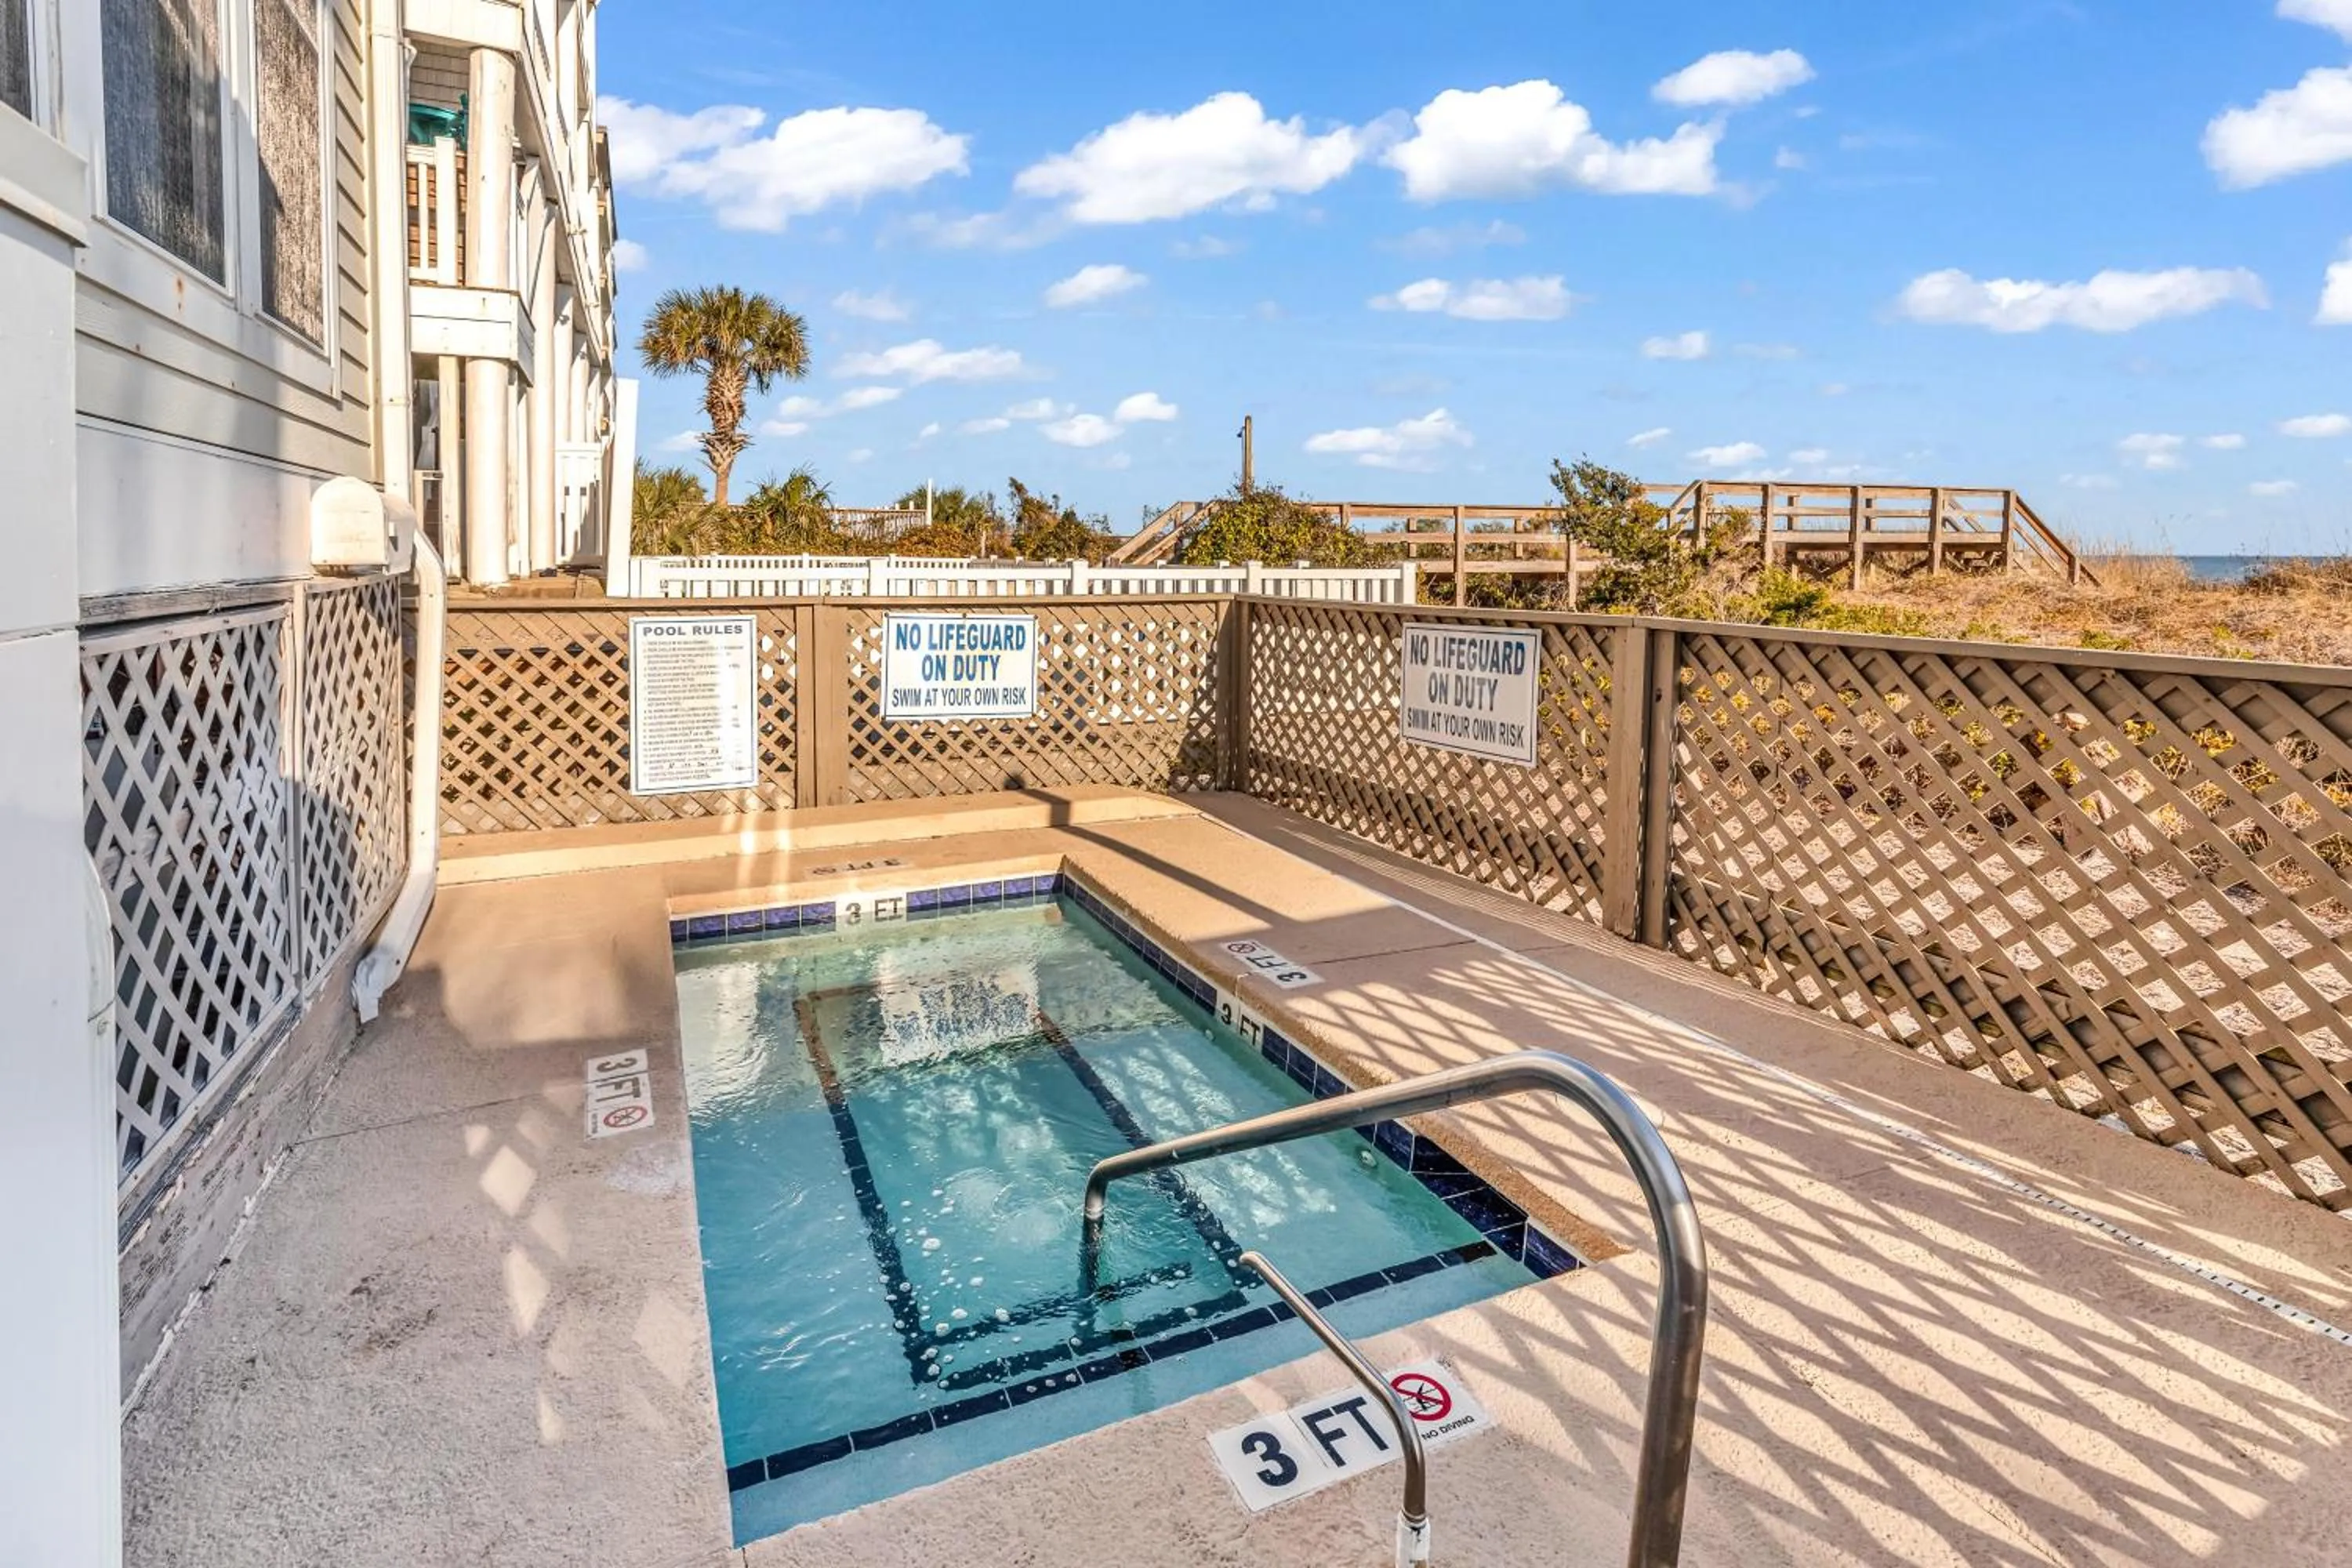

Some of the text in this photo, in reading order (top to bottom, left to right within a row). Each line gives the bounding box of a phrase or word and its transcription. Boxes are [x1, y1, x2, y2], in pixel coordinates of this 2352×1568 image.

[643, 625, 743, 637] POOL RULES
[895, 623, 1026, 651] NO LIFEGUARD
[921, 654, 1001, 681] ON DUTY
[1410, 634, 1526, 676] NO LIFEGUARD
[892, 687, 1026, 707] SWIM AT YOUR OWN RISK
[1428, 672, 1498, 712] ON DUTY
[1407, 707, 1525, 747] SWIM AT YOUR OWN RISK
[1245, 954, 1308, 982] 3 FT
[1221, 1003, 1261, 1046] 3 FT
[595, 1057, 641, 1102] 3 FT
[1241, 1396, 1389, 1487] 3 FT
[1421, 1415, 1475, 1440] NO DIVING
